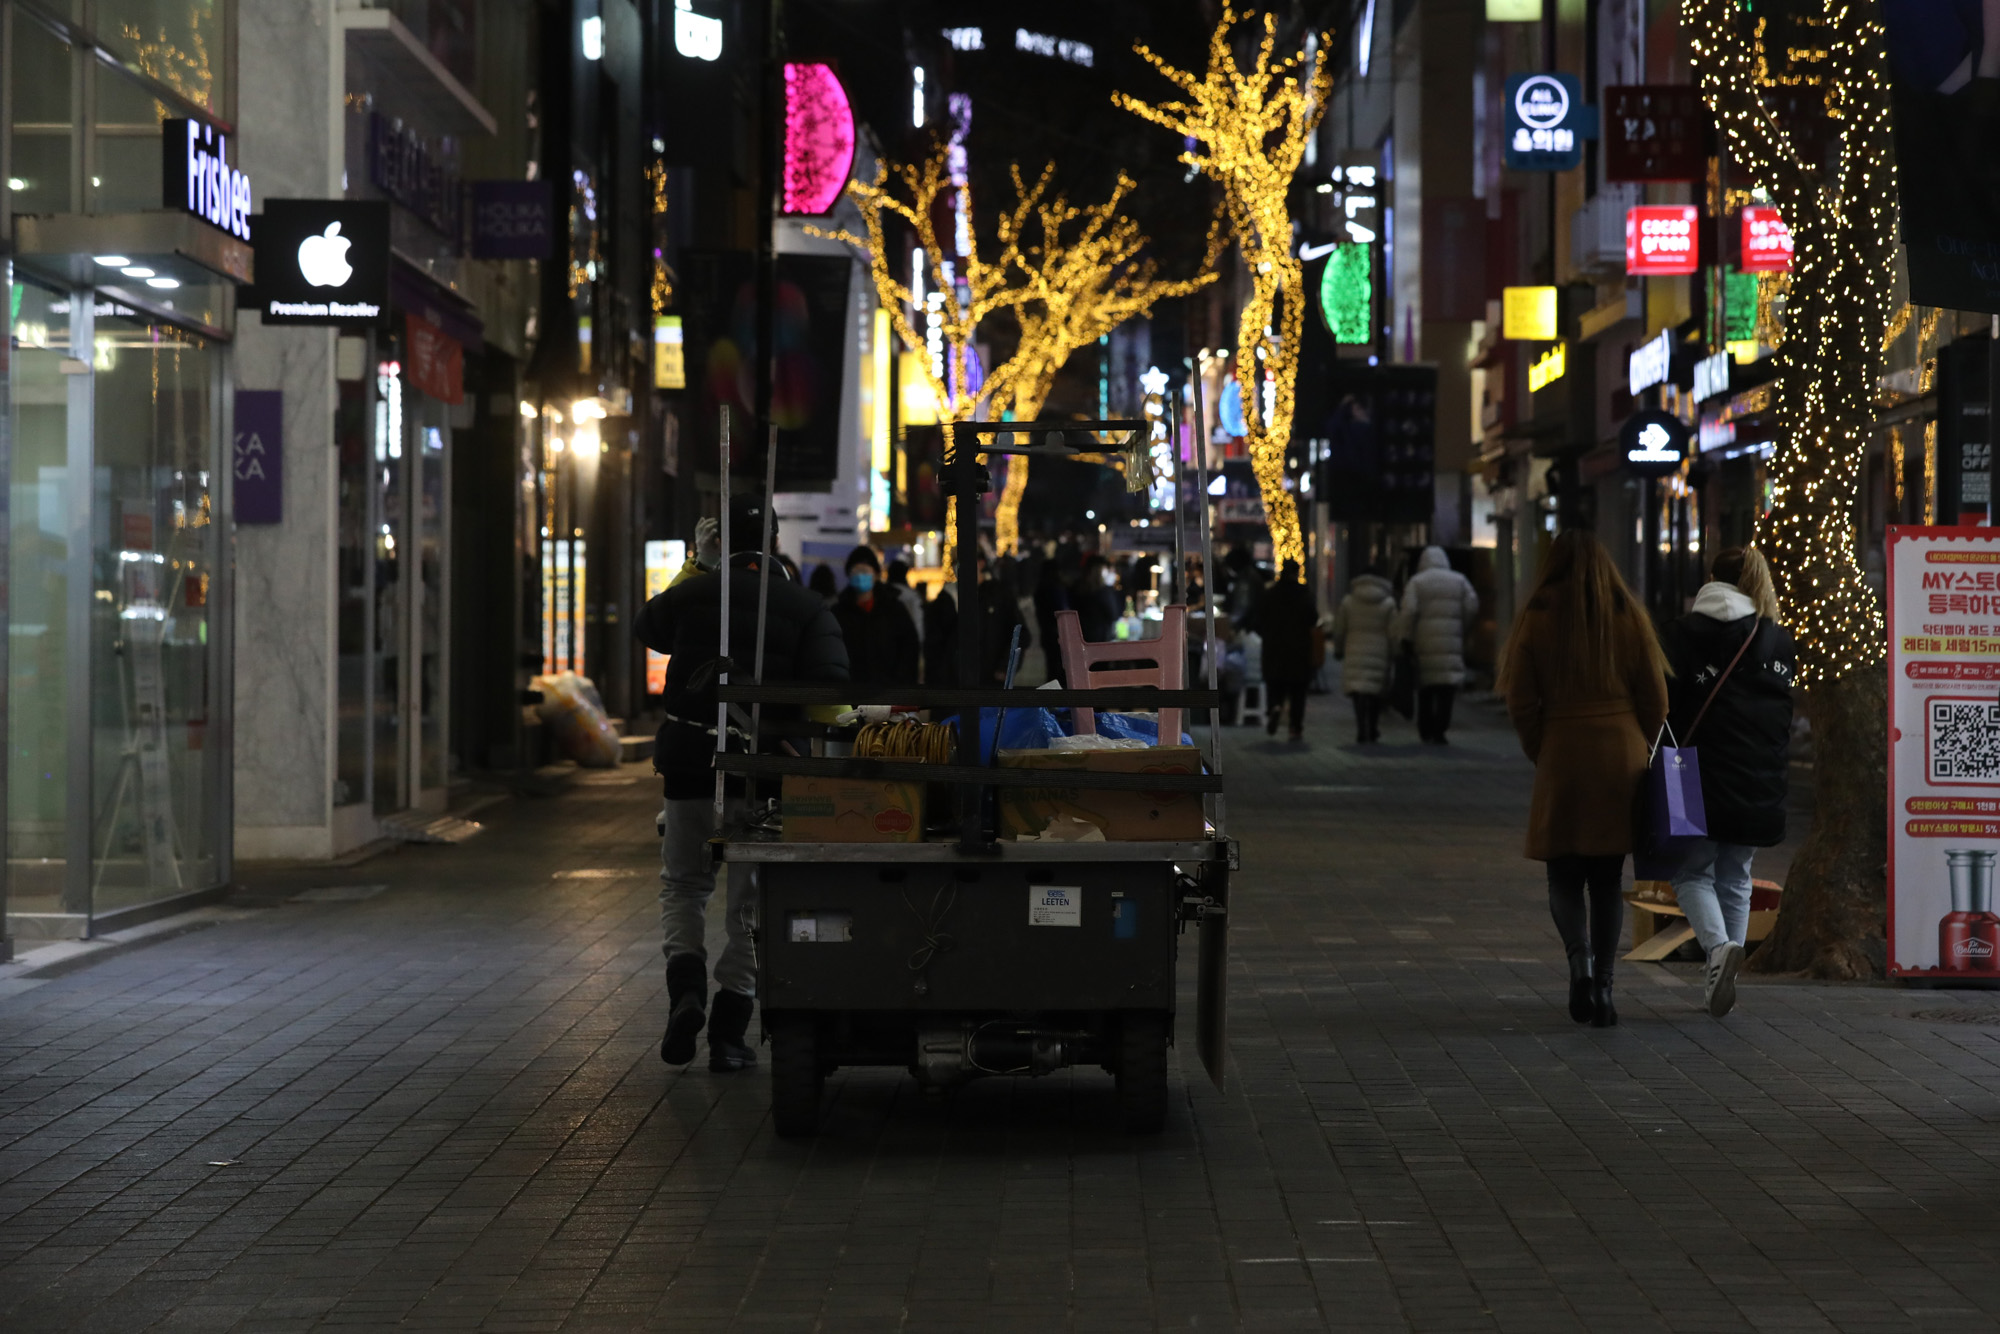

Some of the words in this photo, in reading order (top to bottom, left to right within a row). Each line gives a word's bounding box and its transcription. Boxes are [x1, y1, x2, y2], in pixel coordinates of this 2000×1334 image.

[187, 118, 252, 241] Frisbee
[477, 203, 546, 218] HOLIKA
[477, 220, 546, 236] HOLIKA
[1641, 236, 1690, 255] green
[270, 301, 328, 316] Premium
[329, 302, 380, 317] Reseller
[1968, 625, 1990, 636] 레드
[1904, 638, 1942, 652] 레티놀
[1985, 824, 1998, 834] 5%
[1041, 898, 1070, 906] LEETEN
